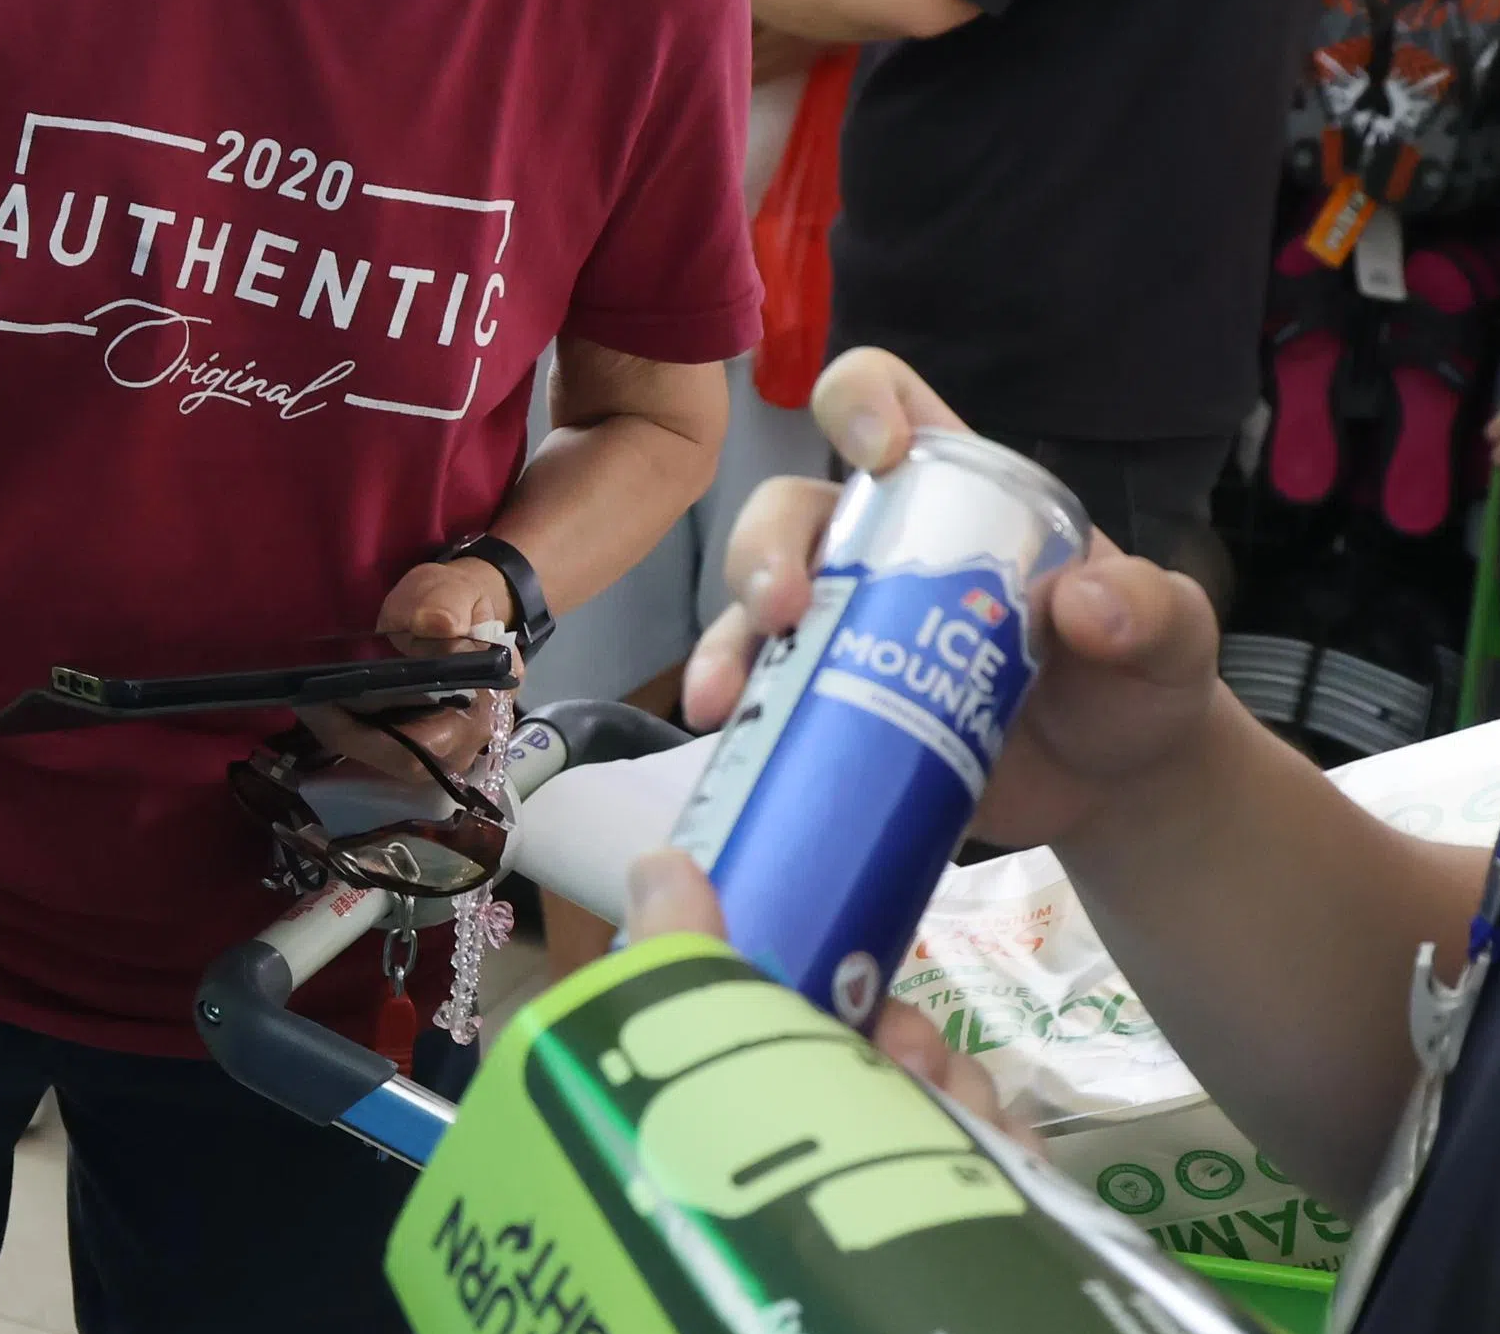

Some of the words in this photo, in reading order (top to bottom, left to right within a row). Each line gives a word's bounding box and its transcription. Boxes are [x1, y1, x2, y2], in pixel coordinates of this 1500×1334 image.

[206, 128, 354, 211] 2020
[84, 297, 355, 420] Original
[915, 605, 1008, 694] ICE
[927, 986, 1031, 1010] TISSUE
